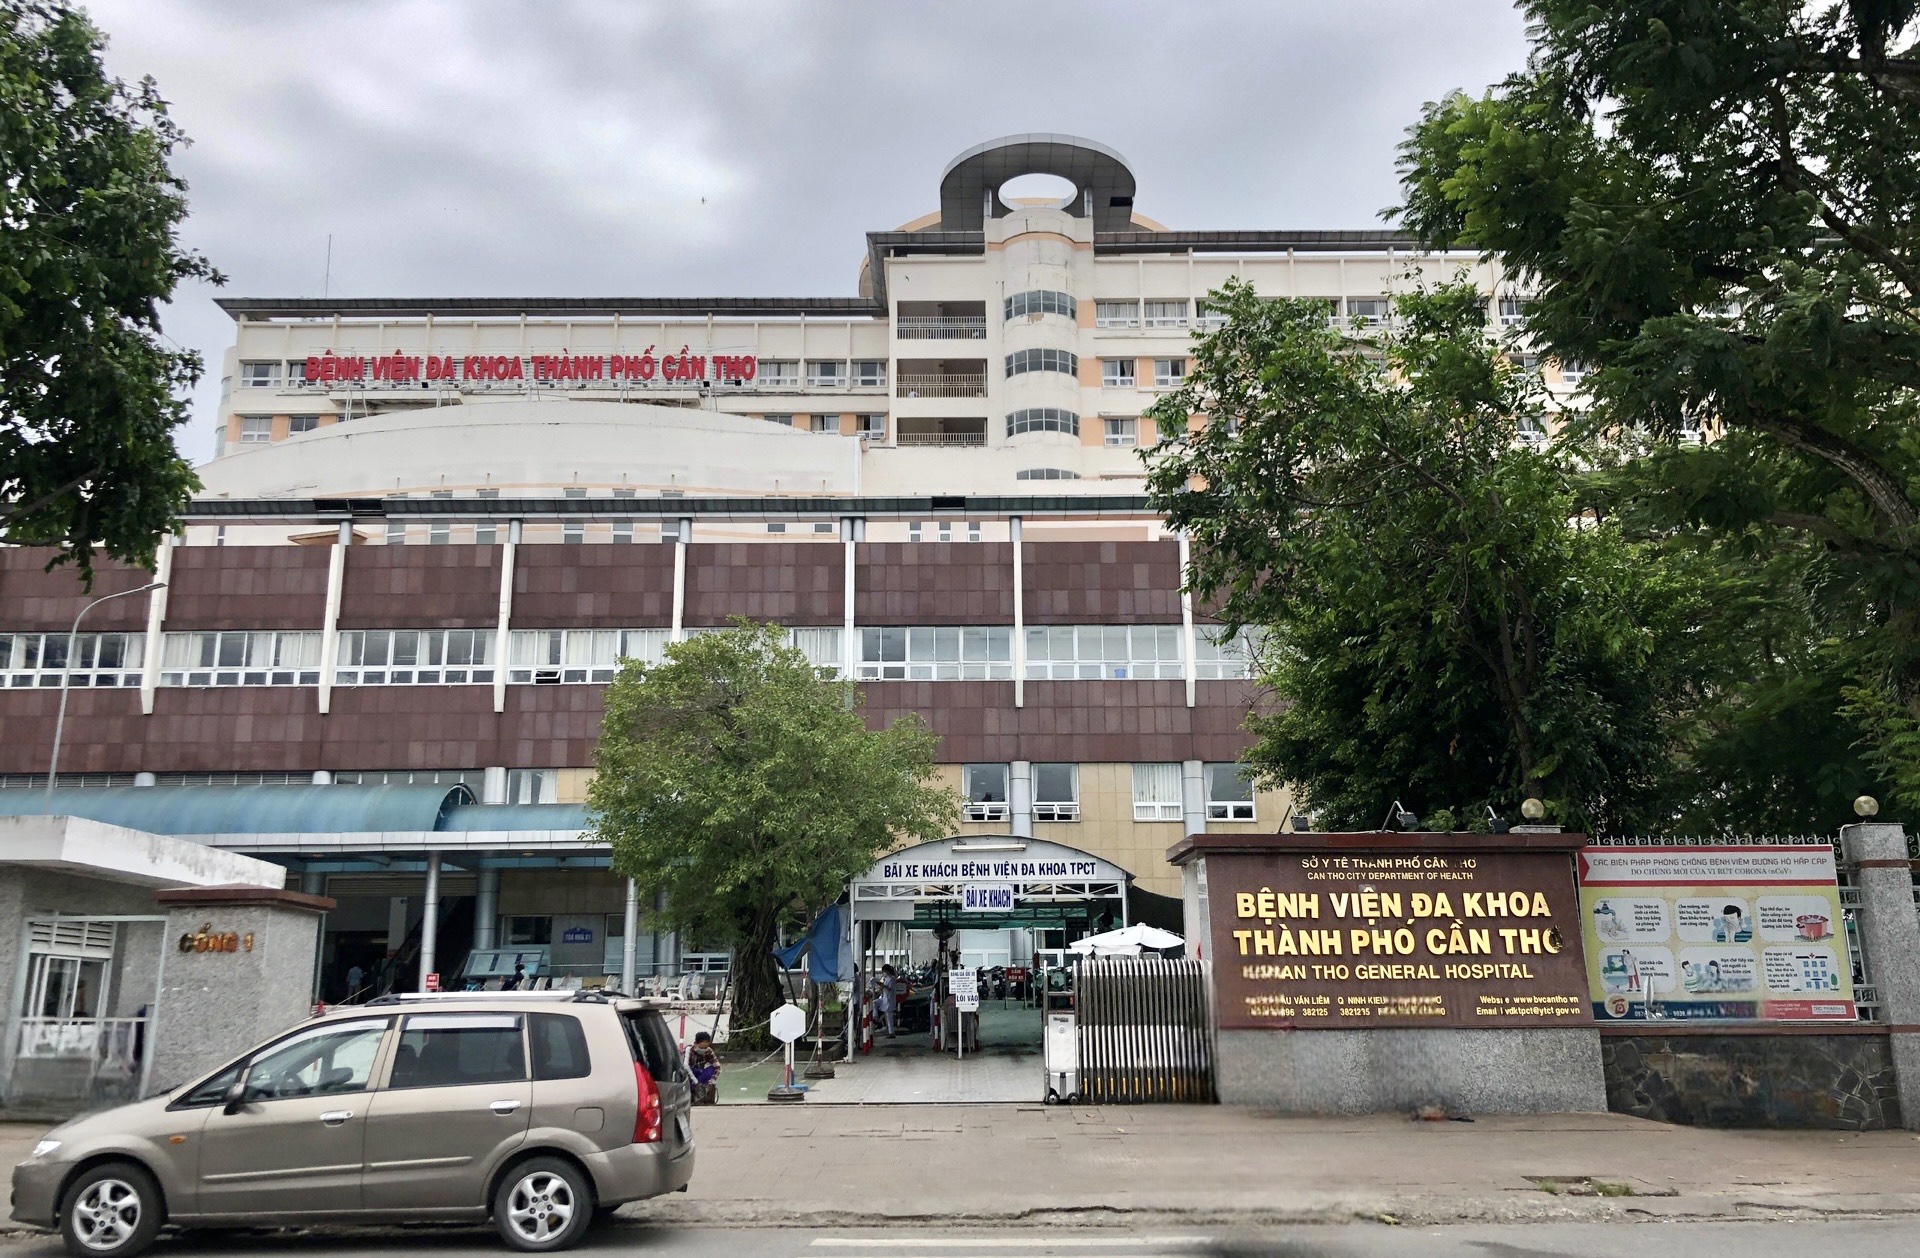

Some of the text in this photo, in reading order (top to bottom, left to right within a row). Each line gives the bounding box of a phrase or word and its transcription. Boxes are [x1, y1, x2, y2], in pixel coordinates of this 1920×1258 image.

[426, 356, 455, 380] ĐA
[463, 356, 523, 380] KHOA
[531, 348, 603, 379] THÀNH
[610, 345, 655, 379] PHỐ
[662, 345, 705, 379] CẦN
[713, 355, 756, 379] THƠ
[884, 861, 1096, 879] BÃI XE KHÁCH BỆNH VIỆN ĐA KHOA TPCT
[1301, 855, 1319, 868] SỞ
[1322, 859, 1329, 868] Y
[1396, 856, 1420, 868] PHỐ
[1307, 872, 1473, 880] CAN THO CITY DEPARTMENT OF HEALTH
[979, 890, 987, 907] XE
[989, 886, 1011, 907] KHÁCH
[1236, 886, 1552, 926] BỆNH VIỆN ĐA KHOA
[244, 933, 253, 953] 1
[1233, 923, 1342, 955] THÀNH
[1426, 919, 1491, 955] CẦN
[1312, 965, 1349, 979] THO
[1355, 965, 1440, 979] GENERAL
[1445, 964, 1534, 979] HOSPITAL
[1348, 997, 1366, 1005] NINH
